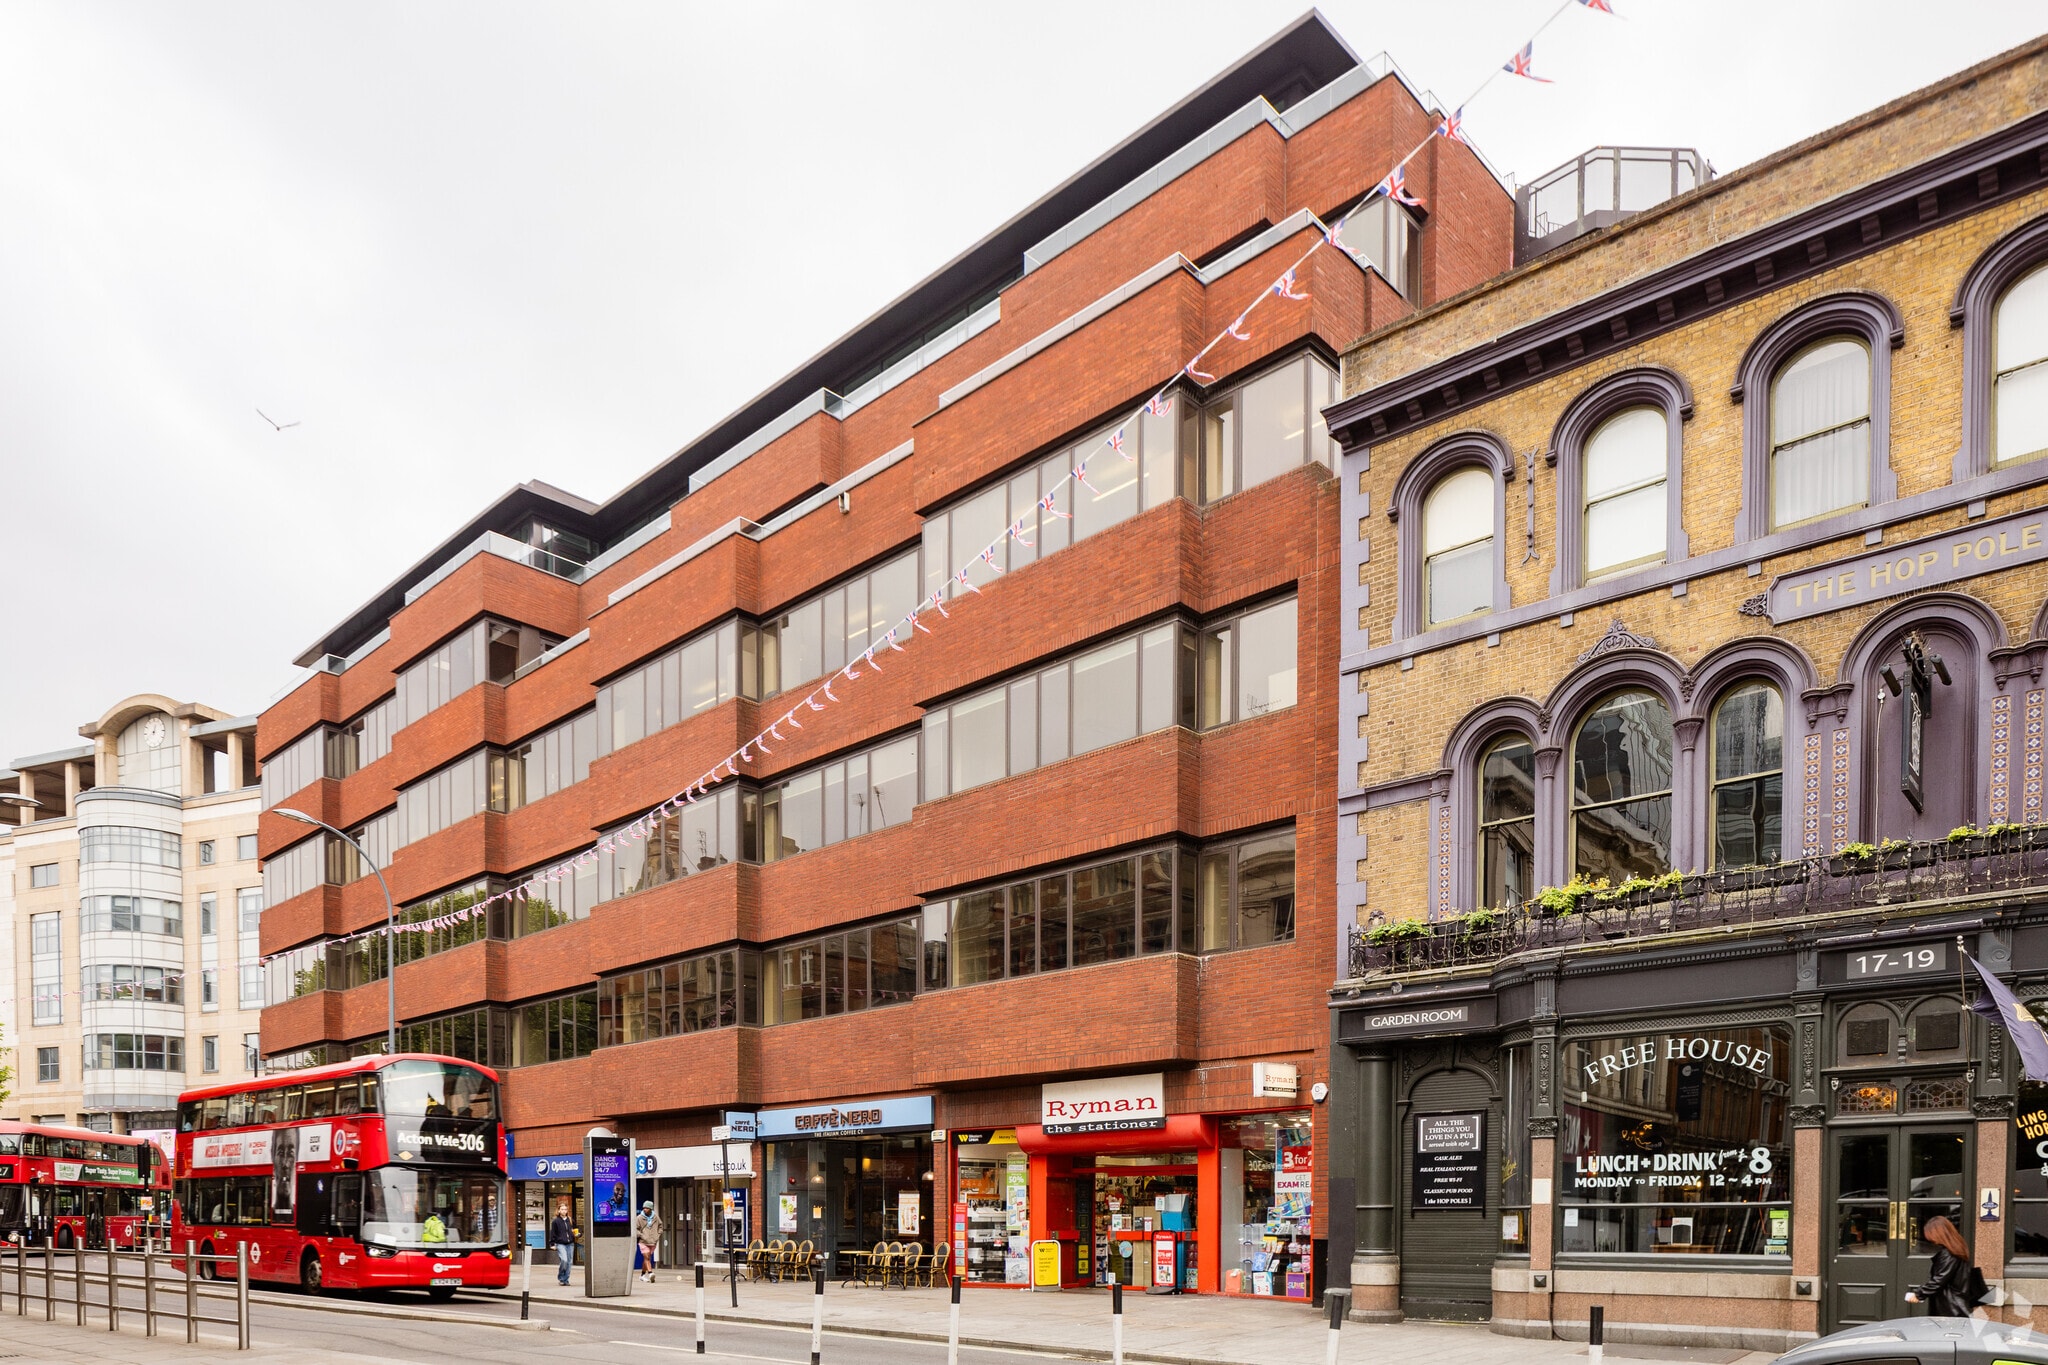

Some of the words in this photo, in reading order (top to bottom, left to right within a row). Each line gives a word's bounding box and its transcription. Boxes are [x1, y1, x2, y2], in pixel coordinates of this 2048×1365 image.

[1788, 570, 1856, 608] THE
[1870, 550, 1940, 589] HOP
[1952, 522, 2043, 568] POLE
[1856, 949, 1935, 974] 17-19
[1371, 1014, 1419, 1027] GARDEN
[1421, 1009, 1462, 1023] ROOM
[1583, 1041, 1657, 1085] FREE
[1665, 1037, 1772, 1074] HOUSE
[1265, 1074, 1294, 1084] Ryman
[840, 1109, 882, 1125] NERO
[1046, 1097, 1158, 1119] Ryman
[1046, 1125, 1073, 1133] the
[1078, 1120, 1158, 1132] stationer
[397, 1132, 433, 1145] Acton
[434, 1134, 459, 1147] Vale
[458, 1134, 485, 1151] 306
[551, 1160, 579, 1173] Opticians
[713, 1158, 747, 1172] tsbco.uk
[1283, 1151, 1294, 1169] 3
[1294, 1153, 1308, 1164] for
[1576, 1154, 1639, 1173] LUNCH
[1653, 1151, 1718, 1172] DRINK
[1718, 1148, 1738, 1166] from
[1277, 1181, 1299, 1189] EXAM
[1575, 1176, 1633, 1188] MONDAY
[1648, 1175, 1702, 1187] FRIDAY
